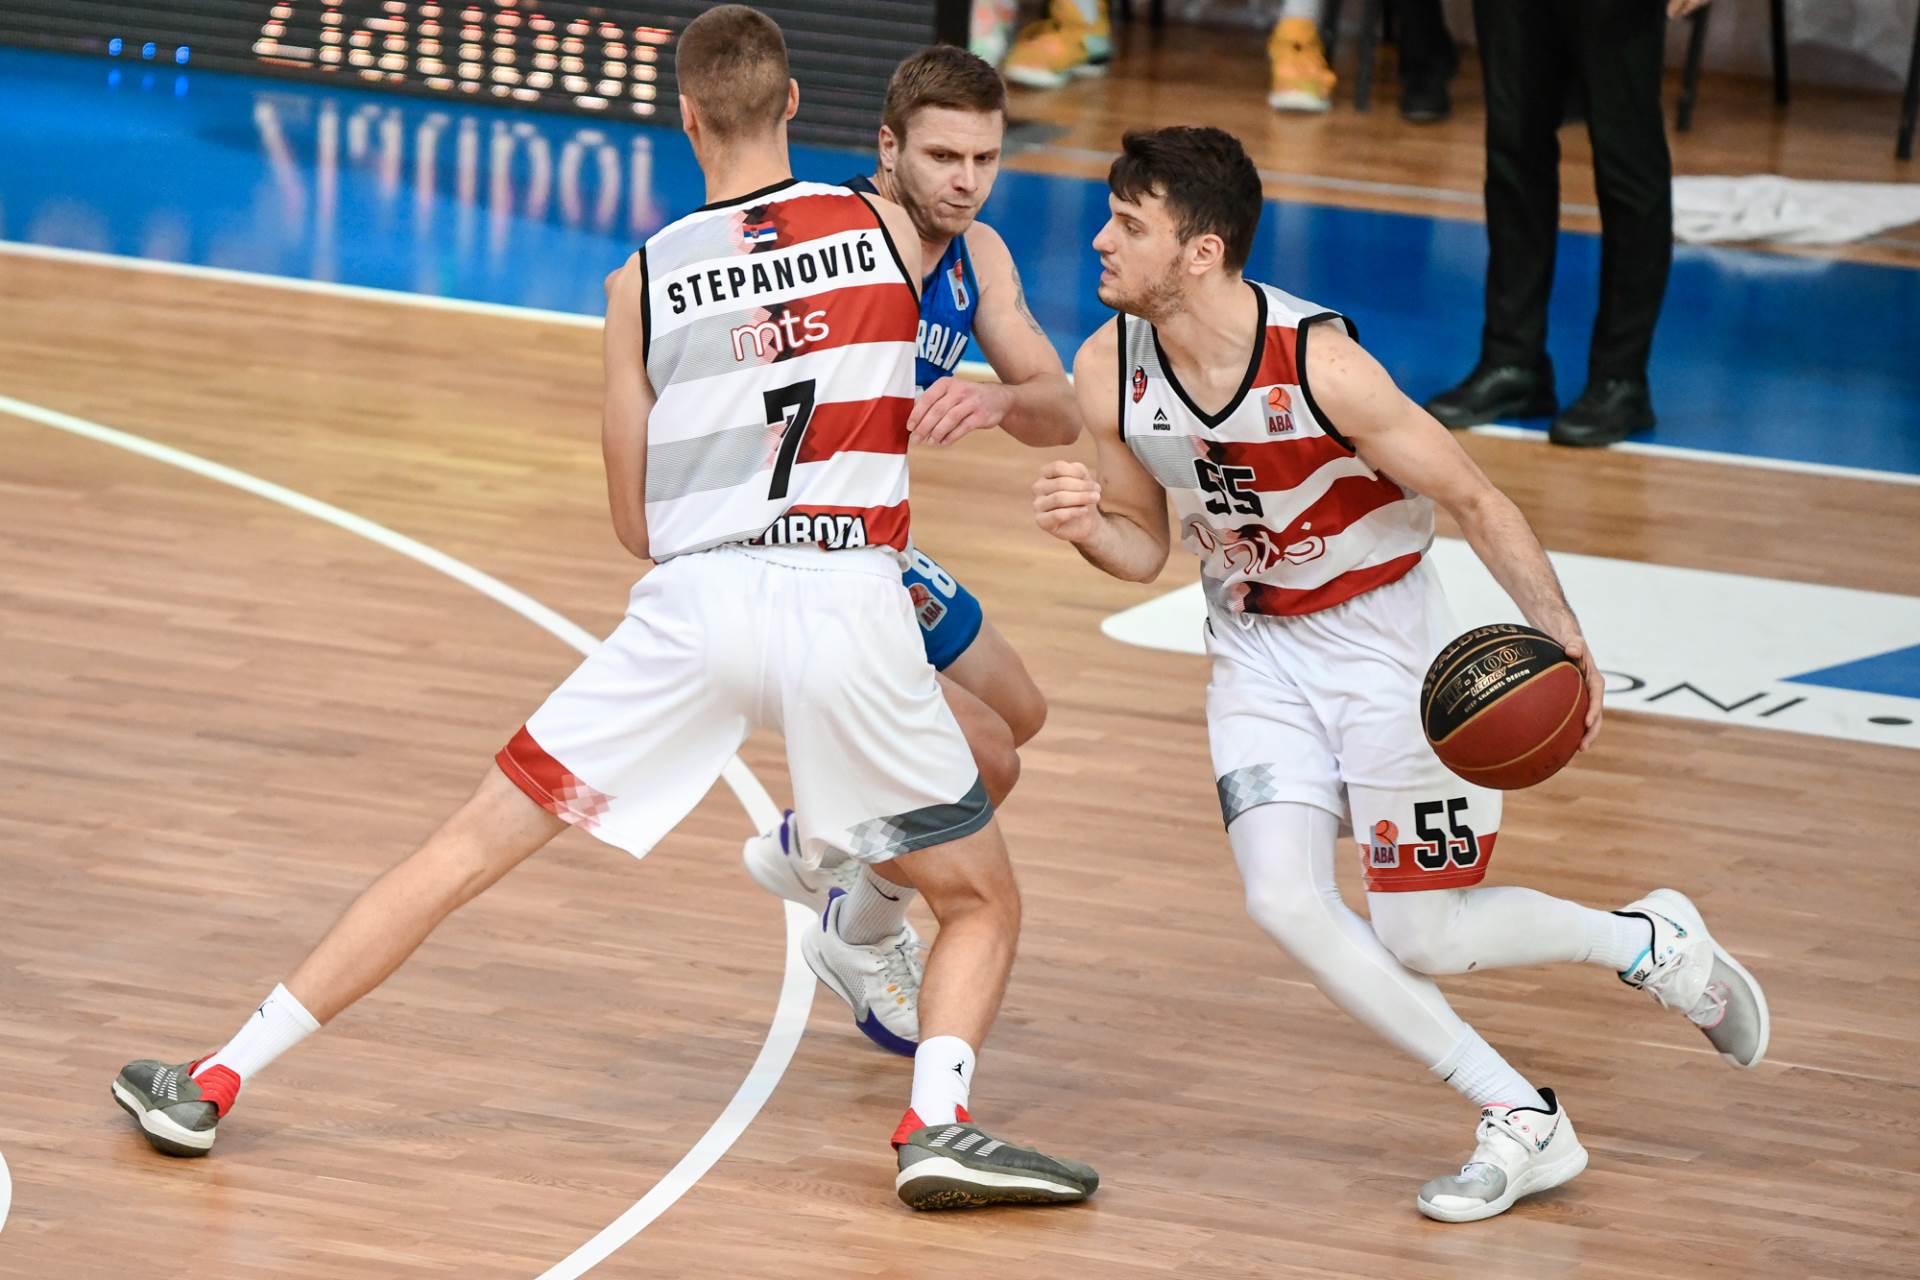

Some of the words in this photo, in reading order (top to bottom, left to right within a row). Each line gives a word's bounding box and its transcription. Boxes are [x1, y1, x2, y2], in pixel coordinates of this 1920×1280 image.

[667, 233, 876, 314] STEPANOVIĆ
[730, 309, 830, 361] mts
[763, 378, 816, 500] 7
[1269, 413, 1294, 433] ABA
[1194, 459, 1264, 518] 55
[921, 601, 943, 626] ABA
[1423, 624, 1519, 697] SPALDING
[1373, 846, 1396, 864] ABA
[1413, 796, 1480, 871] 55
